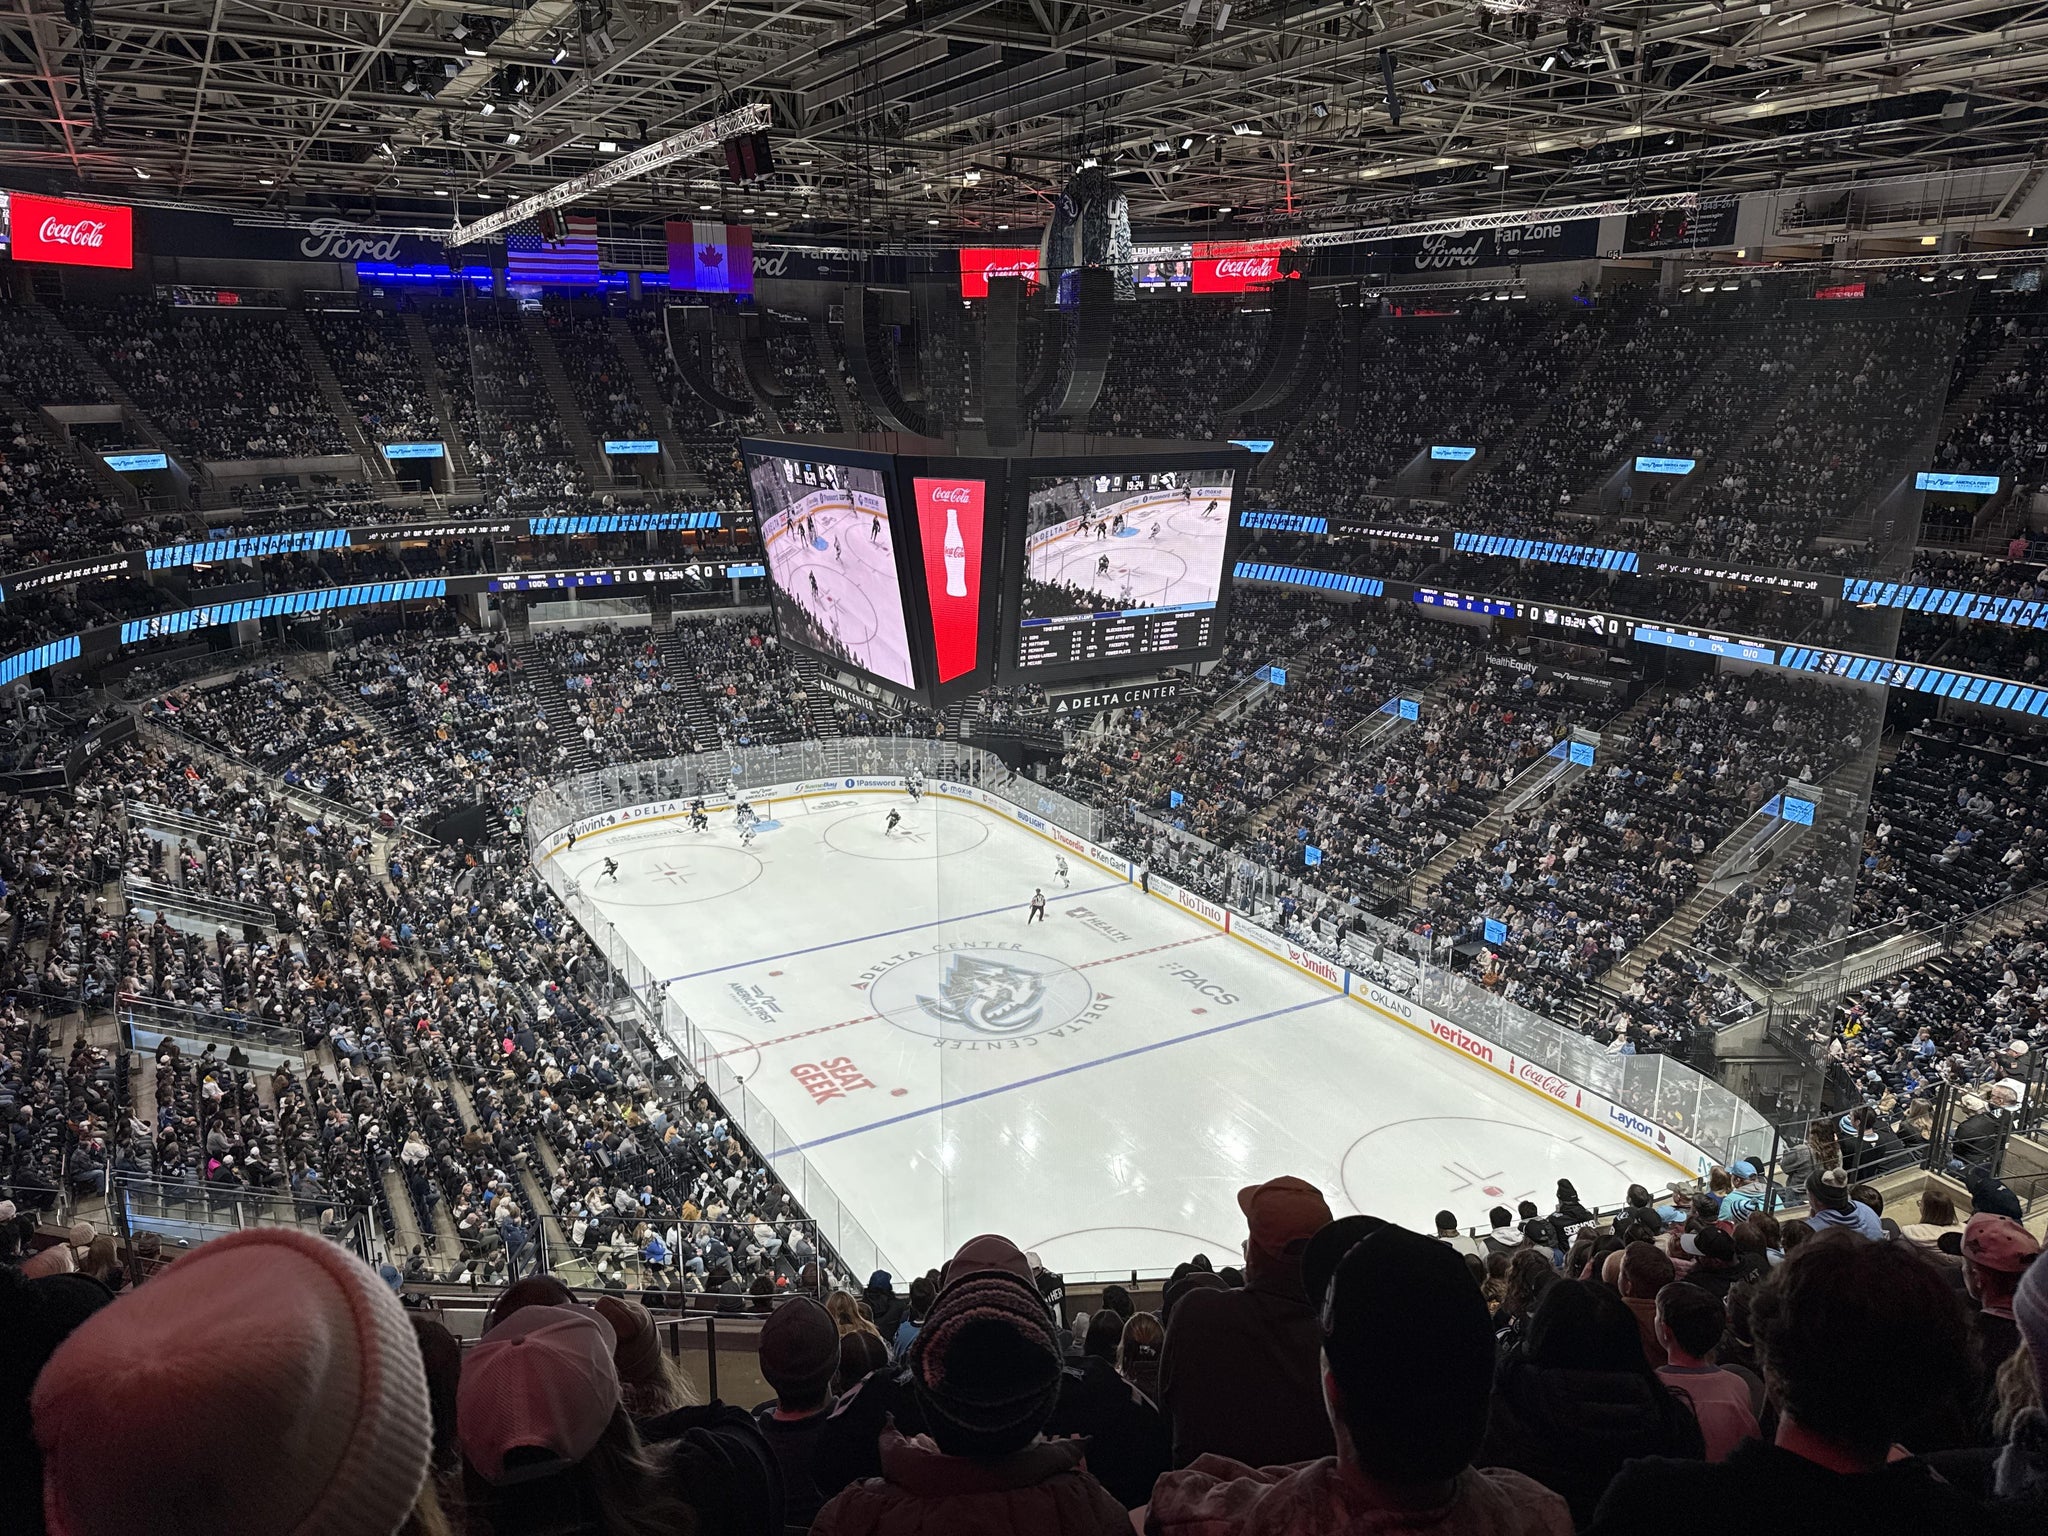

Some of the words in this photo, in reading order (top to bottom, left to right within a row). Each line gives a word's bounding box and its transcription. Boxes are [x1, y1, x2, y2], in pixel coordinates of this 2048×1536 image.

[39, 216, 107, 248] Coca-Cola
[300, 217, 401, 261] Ford
[1494, 227, 1522, 243] Fan
[1524, 223, 1562, 241] Zone
[1414, 229, 1484, 270] Ford
[1215, 255, 1273, 278] Coca-Cola
[932, 486, 971, 504] Coca-Cola
[628, 570, 637, 582] 0
[659, 571, 684, 580] 19:24
[704, 566, 712, 577] 0
[503, 582, 516, 590] 0/0
[528, 580, 548, 588] 100%
[1423, 596, 1434, 604] 0/0
[1443, 599, 1459, 608] 100%
[1530, 607, 1539, 621] 0
[1560, 615, 1586, 629] 19:24
[1608, 620, 1619, 634] 0
[1711, 644, 1724, 653] 0%
[1742, 649, 1758, 659] 0/0
[1485, 654, 1537, 675] HealthEquity
[825, 680, 848, 700] DELTA
[847, 692, 874, 712] CENTER
[1072, 693, 1120, 710] DELTA
[1125, 685, 1176, 702] CENTER
[856, 779, 896, 788] 1Password
[950, 784, 973, 796] moxie
[634, 802, 677, 817] DELTA
[1017, 811, 1029, 823] BUD
[1029, 815, 1045, 831] LIGHT
[1096, 849, 1109, 865] Ken
[1110, 855, 1127, 873] Garff
[1087, 917, 1133, 943] HEALTH
[862, 948, 922, 982] DELTA
[932, 940, 1023, 952] CENTER
[1301, 952, 1338, 983] Smith's
[1170, 968, 1240, 1006] PACS
[728, 982, 759, 1008] AMERICA
[751, 1005, 776, 1024] FIRST
[1370, 990, 1412, 1018] OKLAND
[1049, 1001, 1111, 1039] DELTA
[932, 1036, 1039, 1050] CENTER
[1430, 1018, 1494, 1063] verizon
[790, 1063, 847, 1106] GEEK
[820, 1056, 877, 1092] SEAT
[1519, 1063, 1571, 1100] Coca-Cola
[1609, 1105, 1653, 1138] Layton
